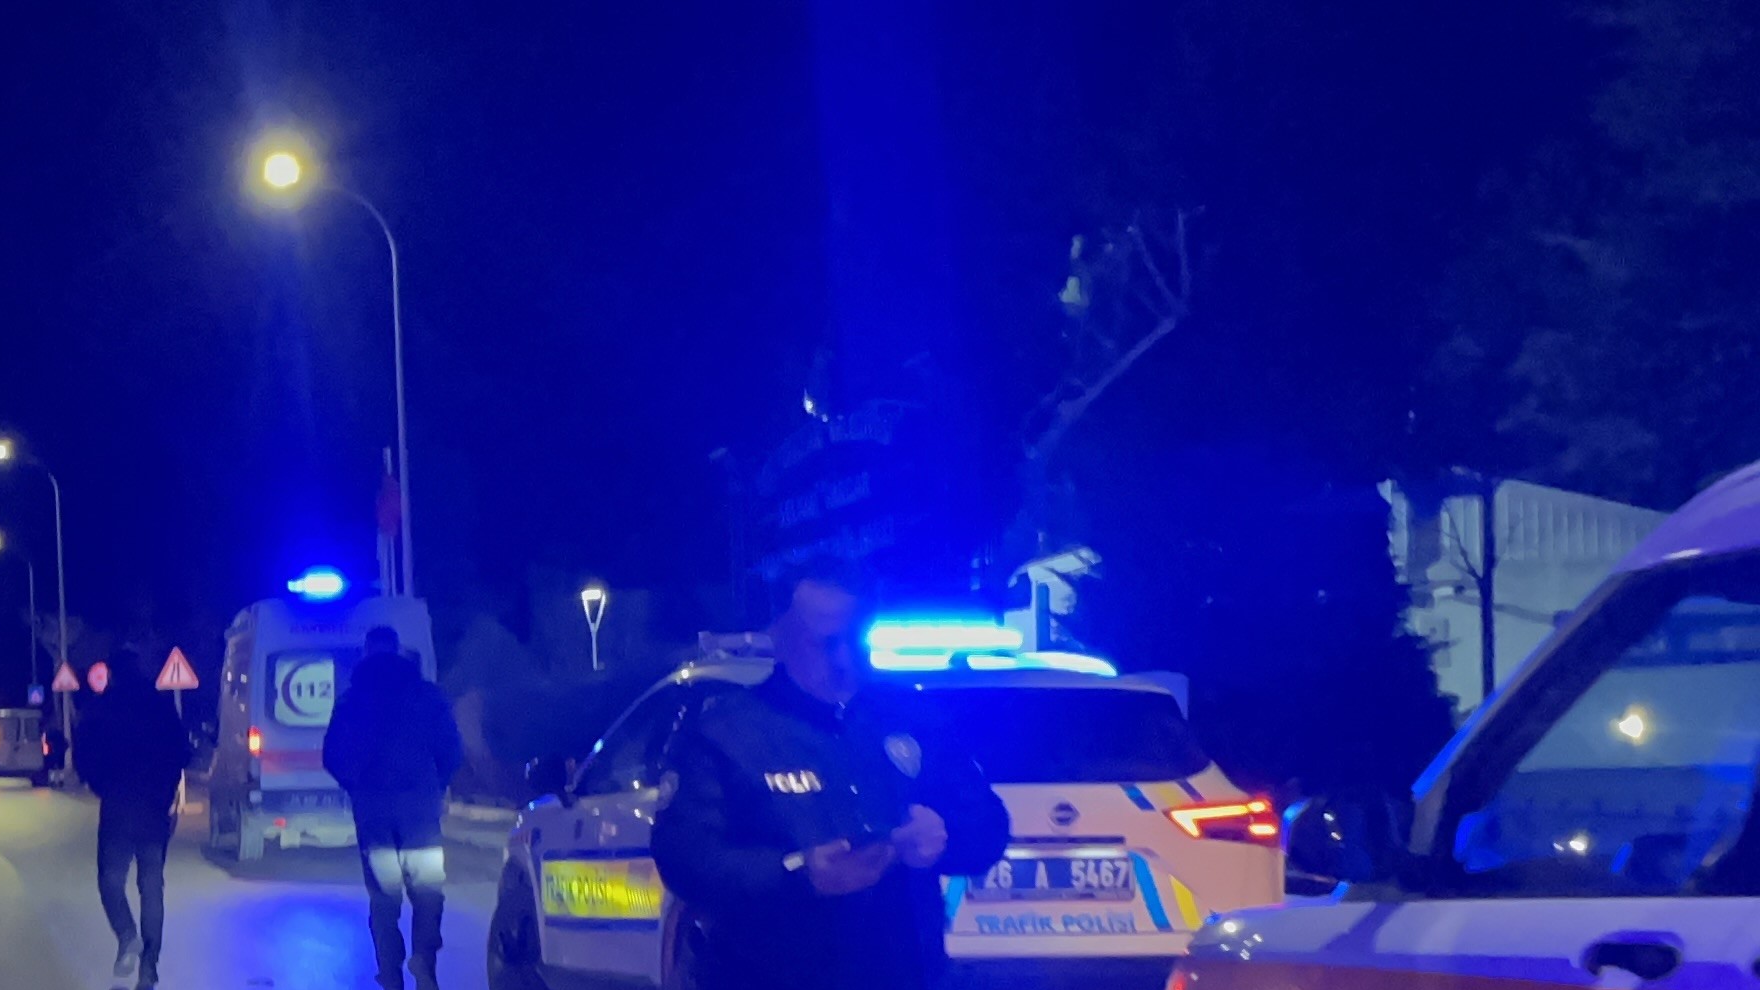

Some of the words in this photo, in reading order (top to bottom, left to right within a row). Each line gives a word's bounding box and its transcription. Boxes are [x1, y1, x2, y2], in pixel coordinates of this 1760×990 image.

[295, 681, 332, 699] 112
[1035, 859, 1049, 890] A
[1071, 859, 1128, 892] 5467
